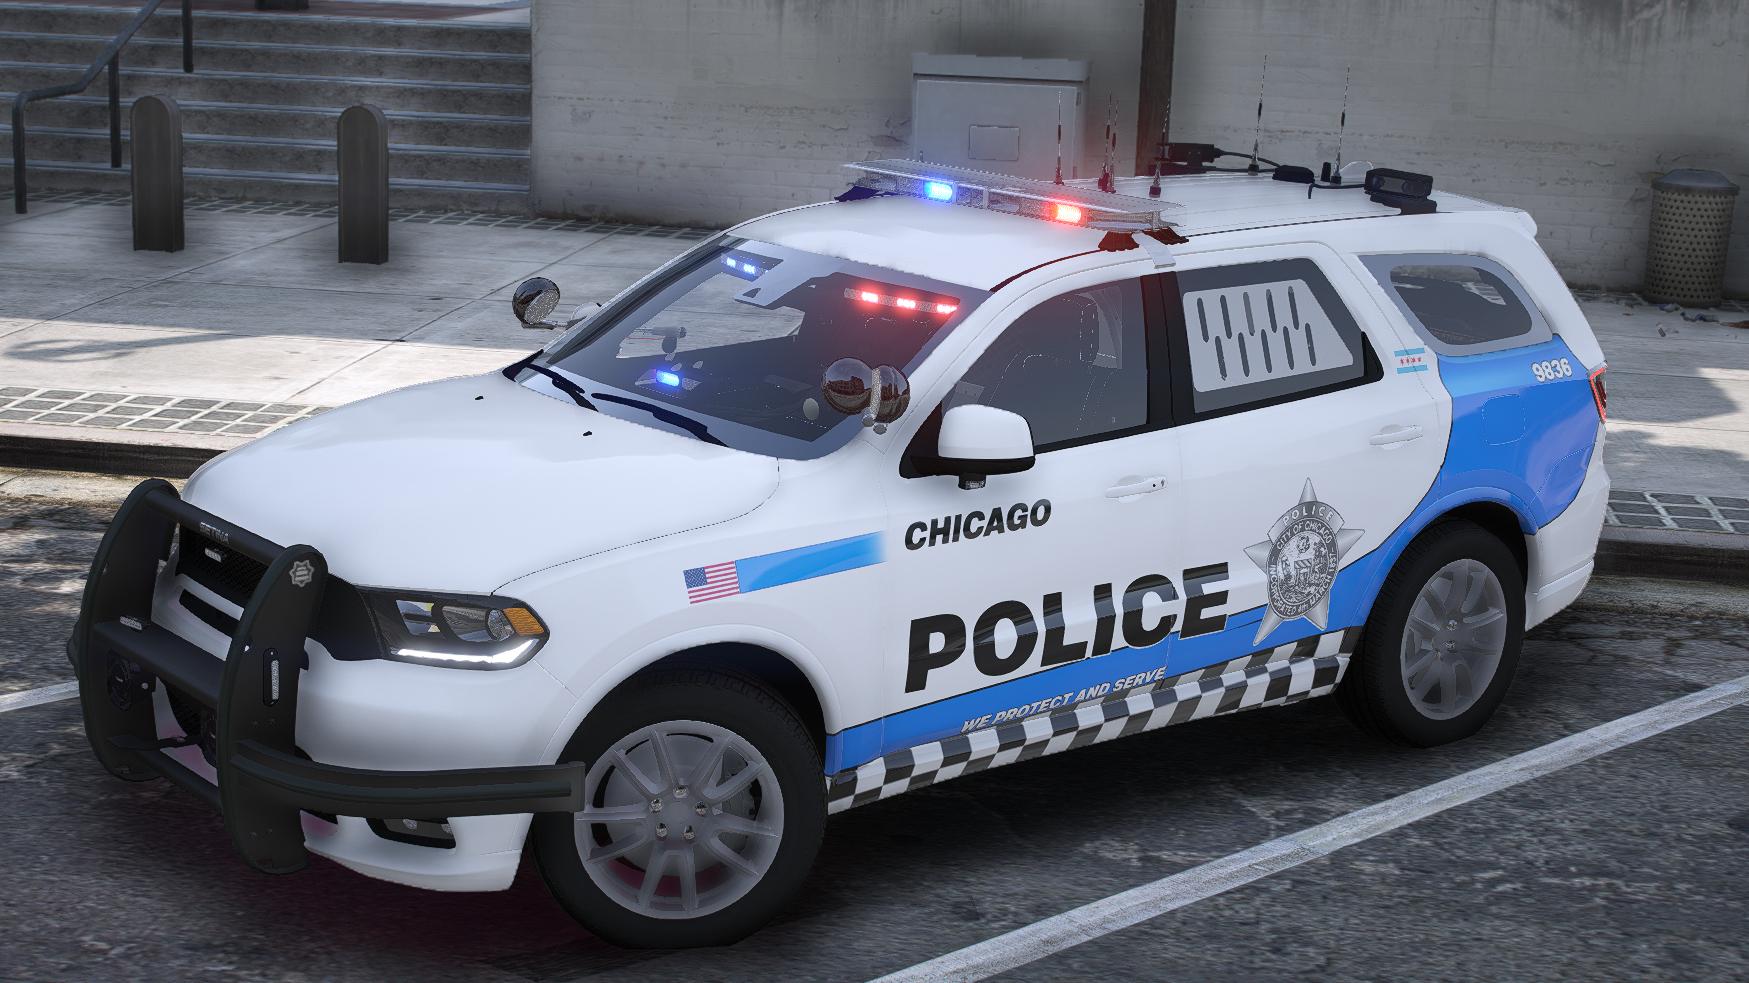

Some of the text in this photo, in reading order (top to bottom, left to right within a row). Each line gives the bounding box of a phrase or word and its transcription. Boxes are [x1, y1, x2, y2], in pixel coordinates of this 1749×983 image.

[905, 499, 1052, 550] CHICAGO
[1276, 520, 1333, 550] CITY OF CHICAGO
[1282, 505, 1334, 526] POLICE
[904, 562, 1229, 693] POLICE
[961, 665, 1168, 734] WE PROTECT AND SERVE
